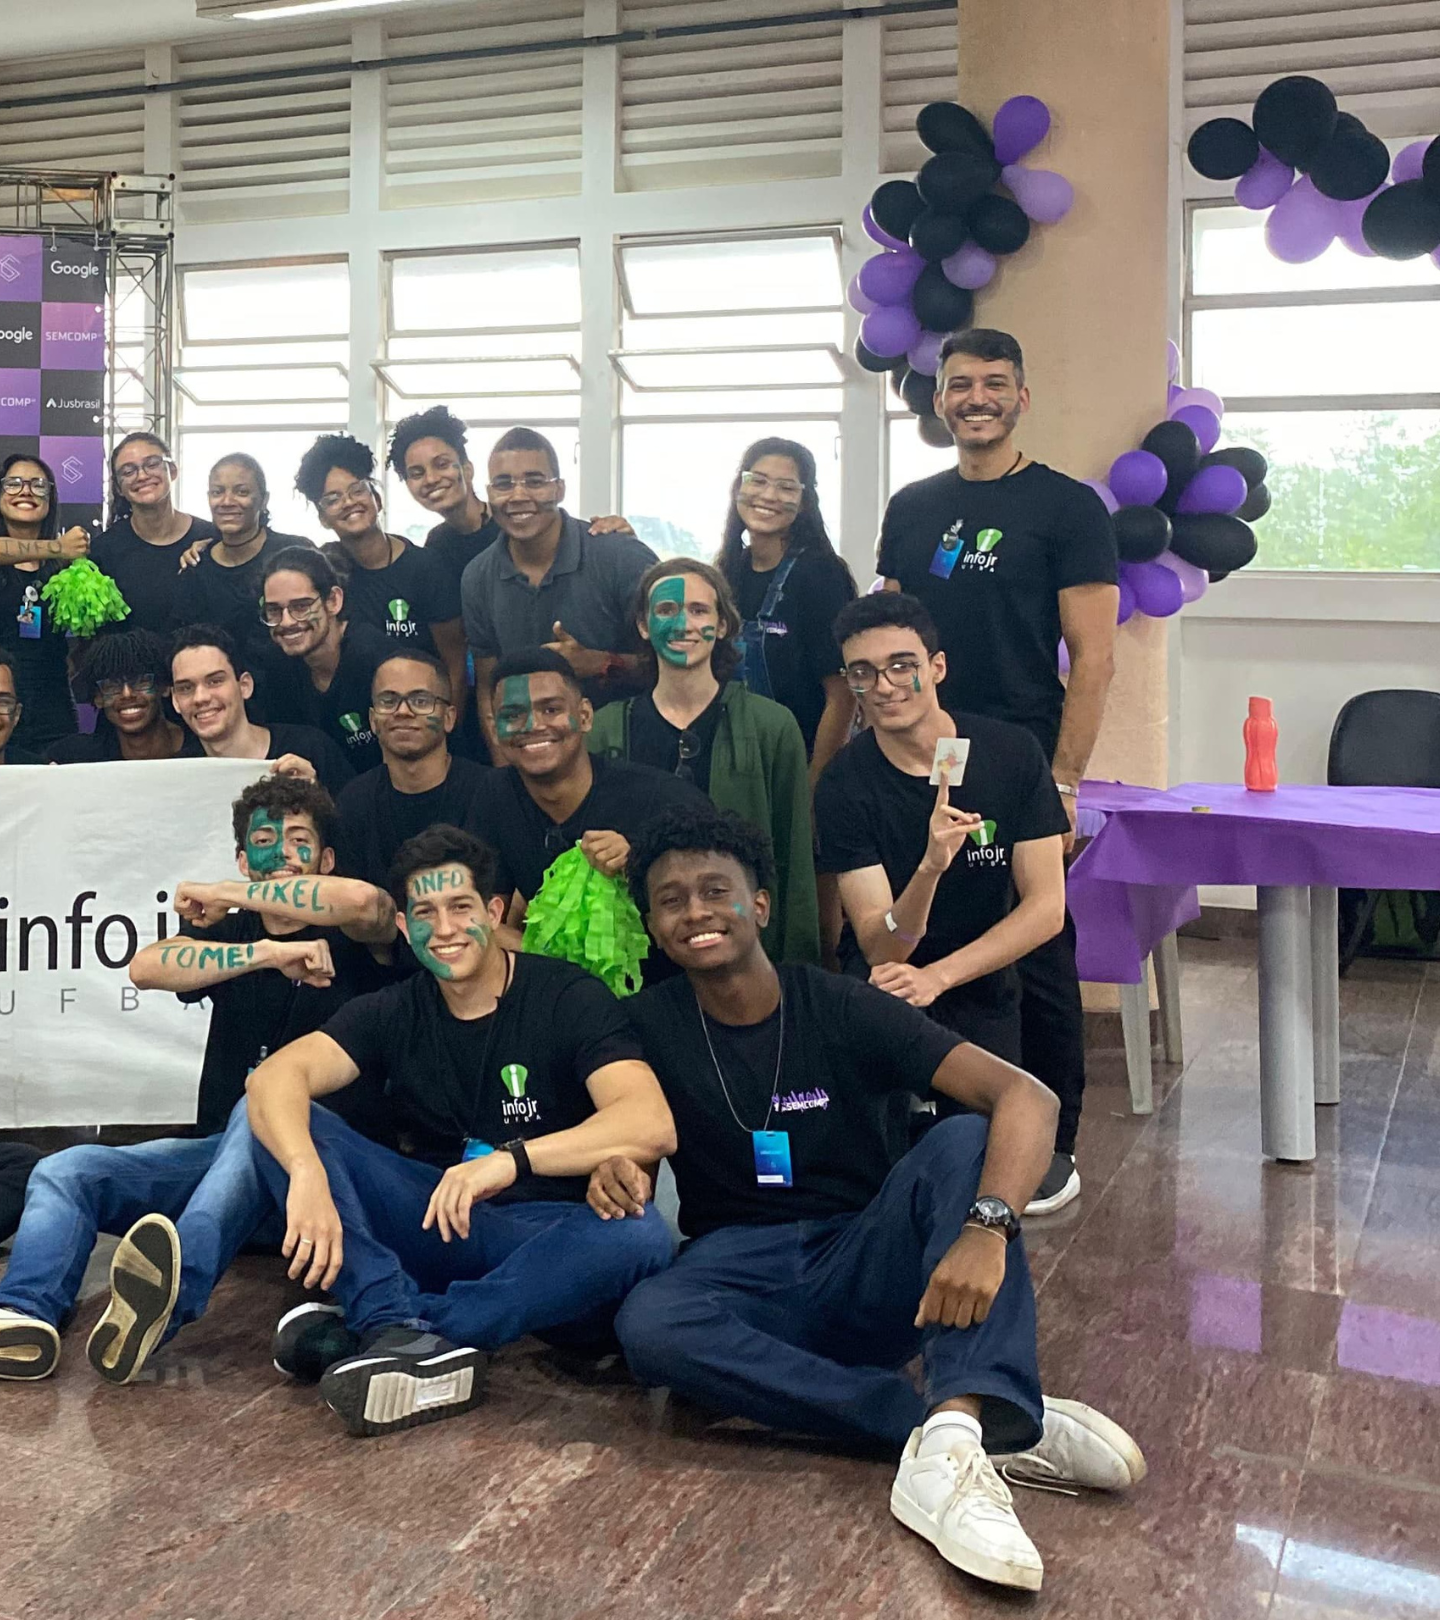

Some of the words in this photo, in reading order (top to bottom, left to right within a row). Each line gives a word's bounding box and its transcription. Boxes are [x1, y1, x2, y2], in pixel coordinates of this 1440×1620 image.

[50, 260, 99, 279] Google
[57, 398, 101, 409] Jusbrasil
[2, 539, 62, 557] INFO
[159, 944, 254, 970] TOME!
